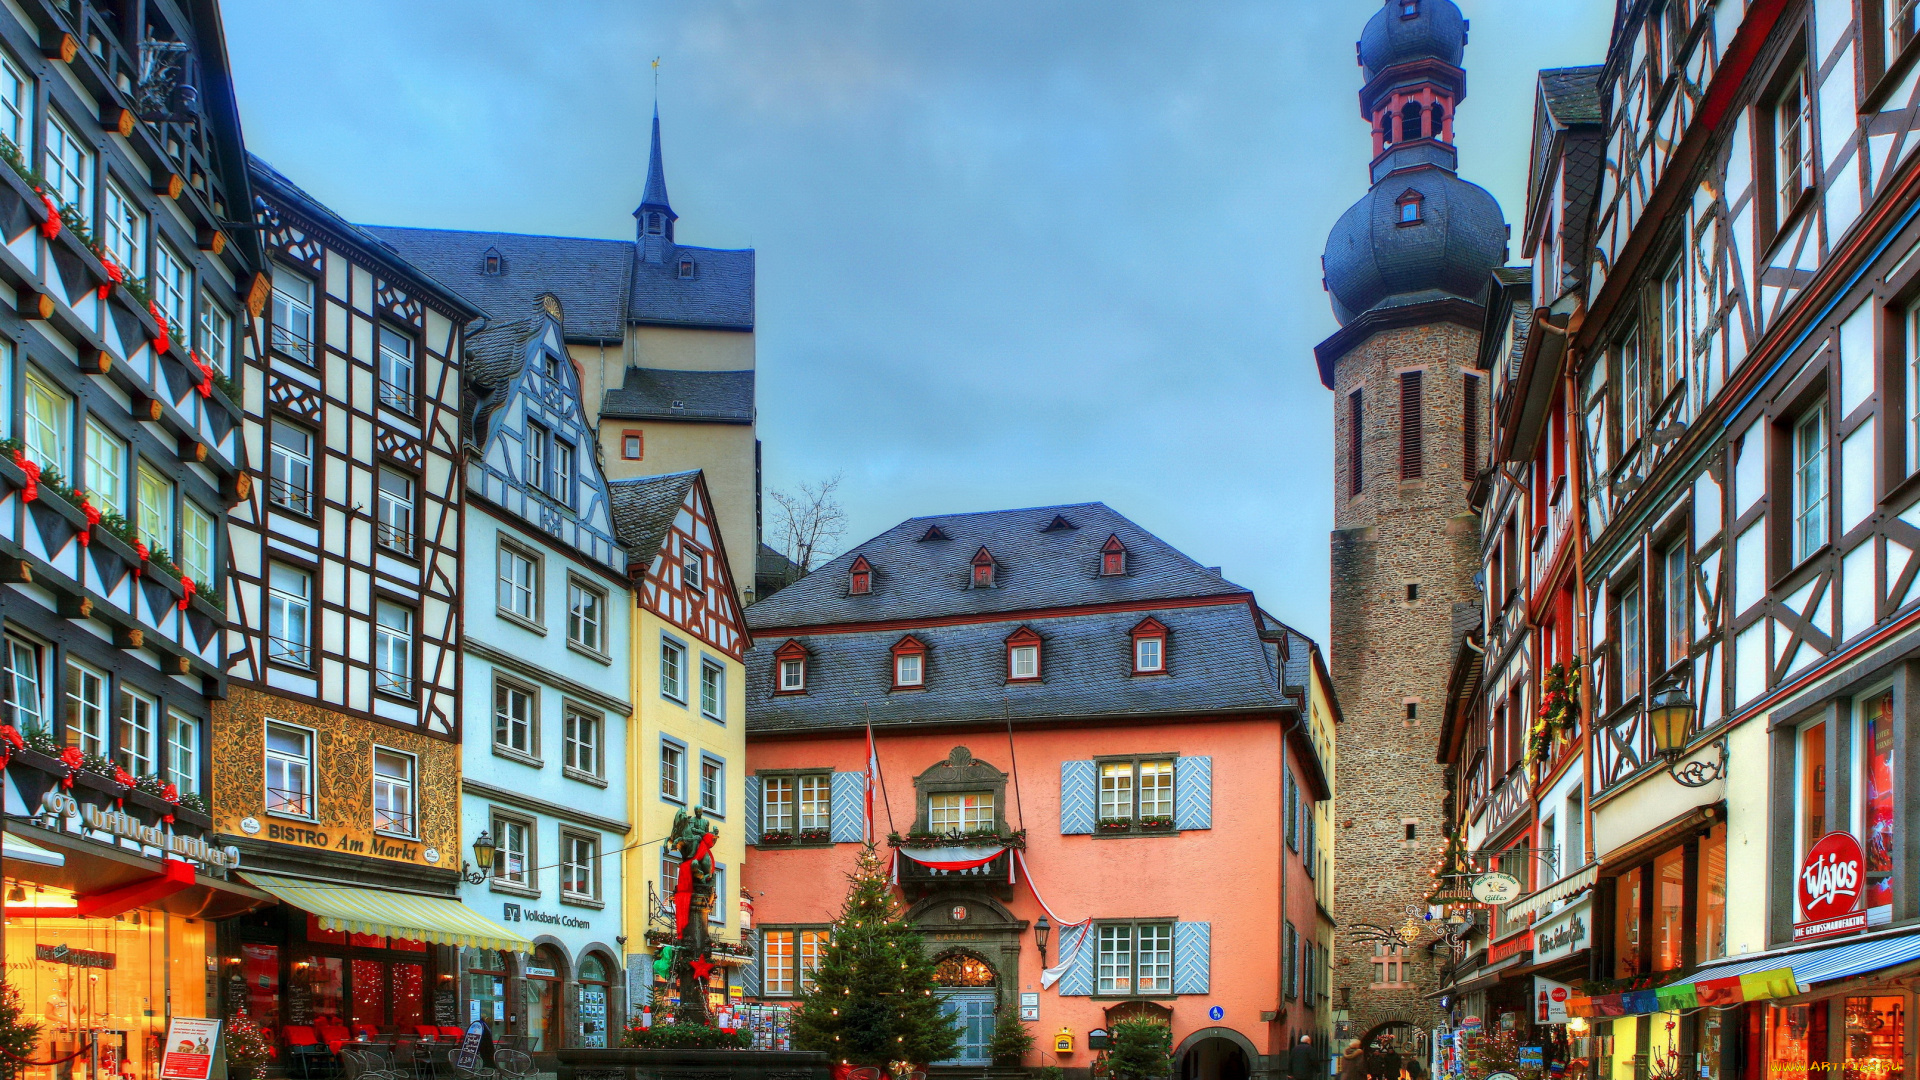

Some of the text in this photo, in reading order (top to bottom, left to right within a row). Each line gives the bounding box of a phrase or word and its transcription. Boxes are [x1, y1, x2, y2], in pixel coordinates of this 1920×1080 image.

[84, 803, 227, 866] brillen müller
[268, 824, 329, 846] BISTRO
[335, 833, 364, 852] Am
[369, 838, 418, 861] Markt
[1485, 894, 1507, 903] Gilles
[523, 909, 590, 929] Volksbank Cochem
[1795, 915, 1864, 937] DIE GENUSSMANUFAKTUR
[935, 933, 984, 941] RATHAUS
